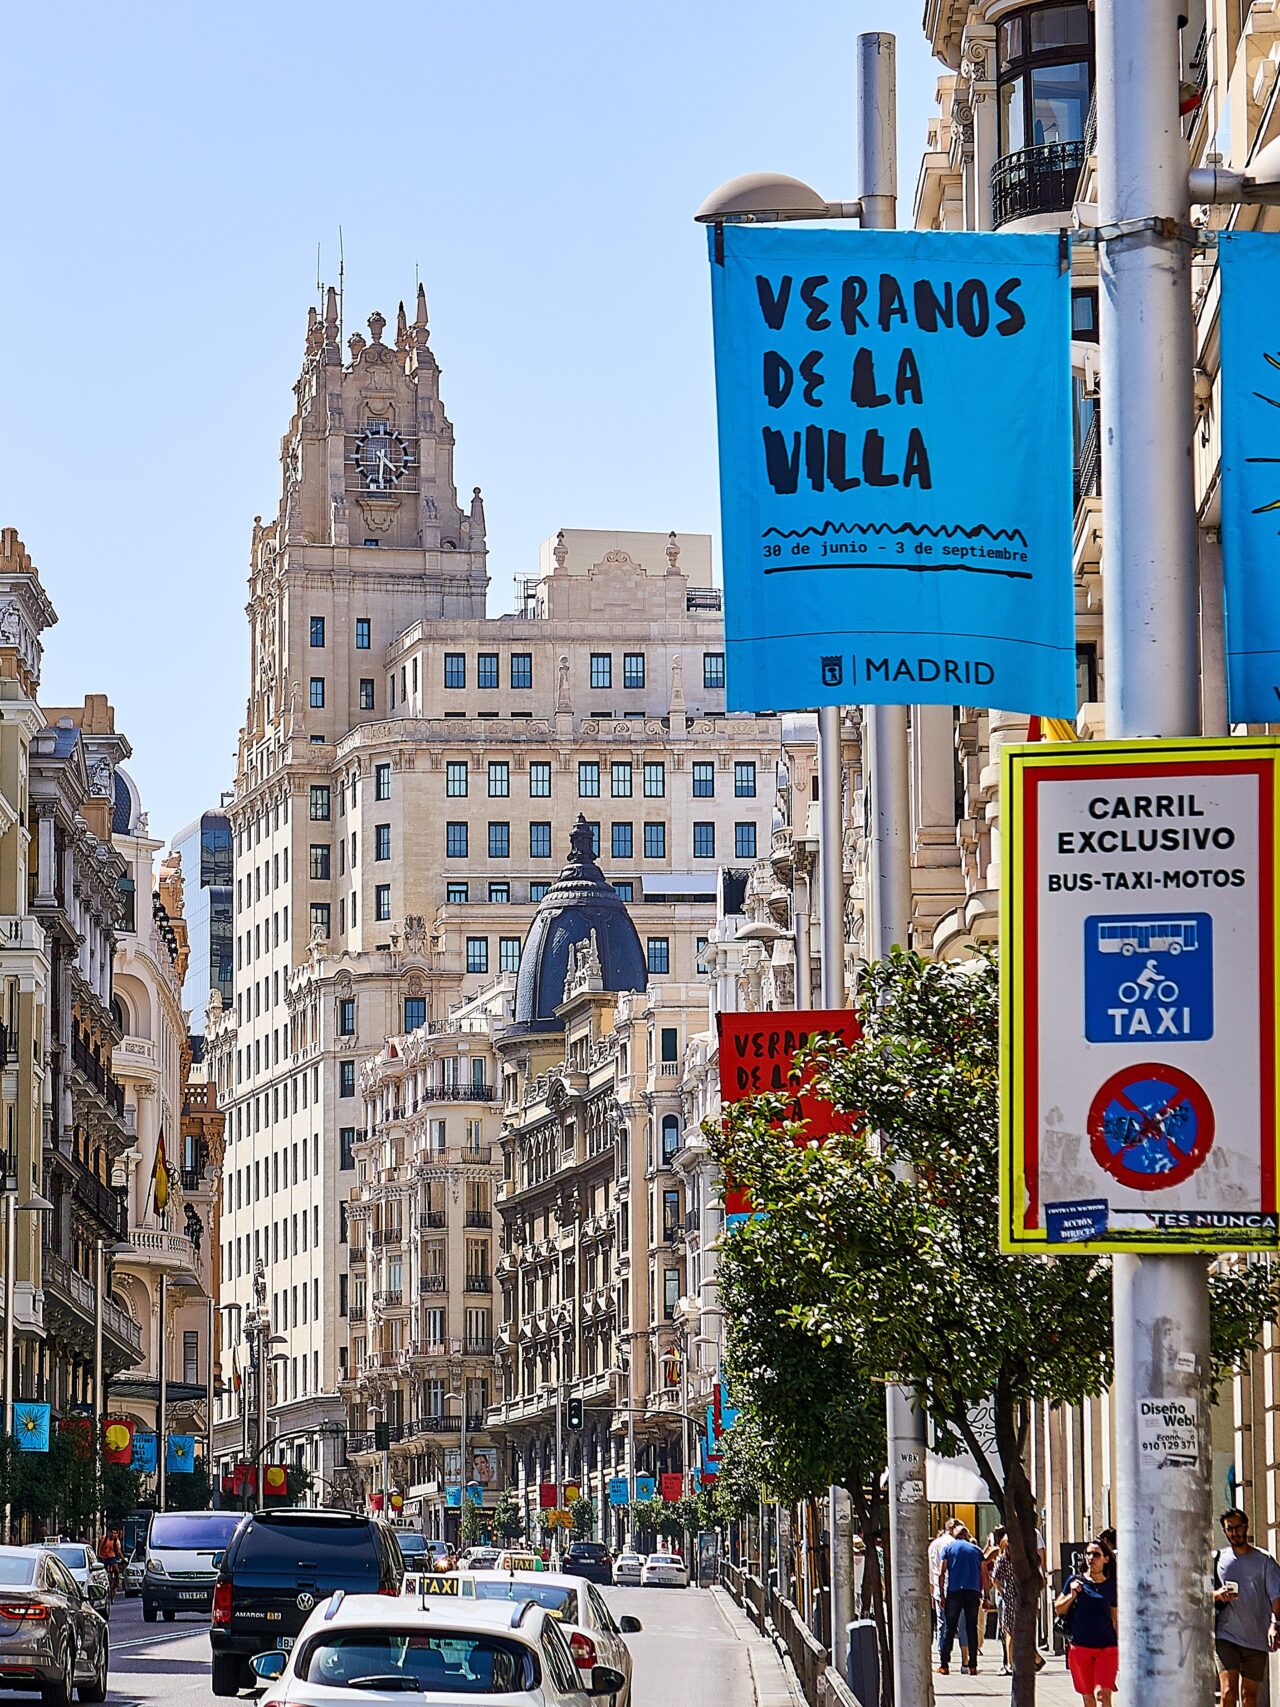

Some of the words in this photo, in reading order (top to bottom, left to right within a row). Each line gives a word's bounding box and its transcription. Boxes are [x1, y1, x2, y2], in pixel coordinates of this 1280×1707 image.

[755, 273, 1026, 338] VERANOS
[762, 350, 826, 408] DE
[850, 347, 924, 408] LA
[762, 424, 932, 494] VILLA
[762, 543, 783, 558] 30
[791, 542, 810, 556] de
[820, 541, 868, 558] junio
[895, 542, 905, 555] 3
[914, 542, 933, 555] de
[942, 544, 1029, 563] septiembre
[865, 657, 996, 685] MADRID
[1088, 794, 1204, 820] CARRIL
[1058, 827, 1235, 854] EXCLUSIVO
[1048, 869, 1246, 893] BUS-TAXI-MOTOS
[1108, 1007, 1191, 1036] TAXI
[734, 1028, 845, 1059] VERA
[737, 1066, 760, 1090] DE
[1196, 1215, 1276, 1228] NUNCA
[1141, 1402, 1186, 1415] Diseño
[1163, 1415, 1195, 1427] Web!
[1142, 1442, 1160, 1451] 910
[1163, 1441, 1179, 1450] 129
[1181, 1441, 1196, 1449] 371
[389, 1519, 415, 1528] ACIA
[514, 1558, 534, 1571] TAXI
[421, 1579, 458, 1595] TAXI
